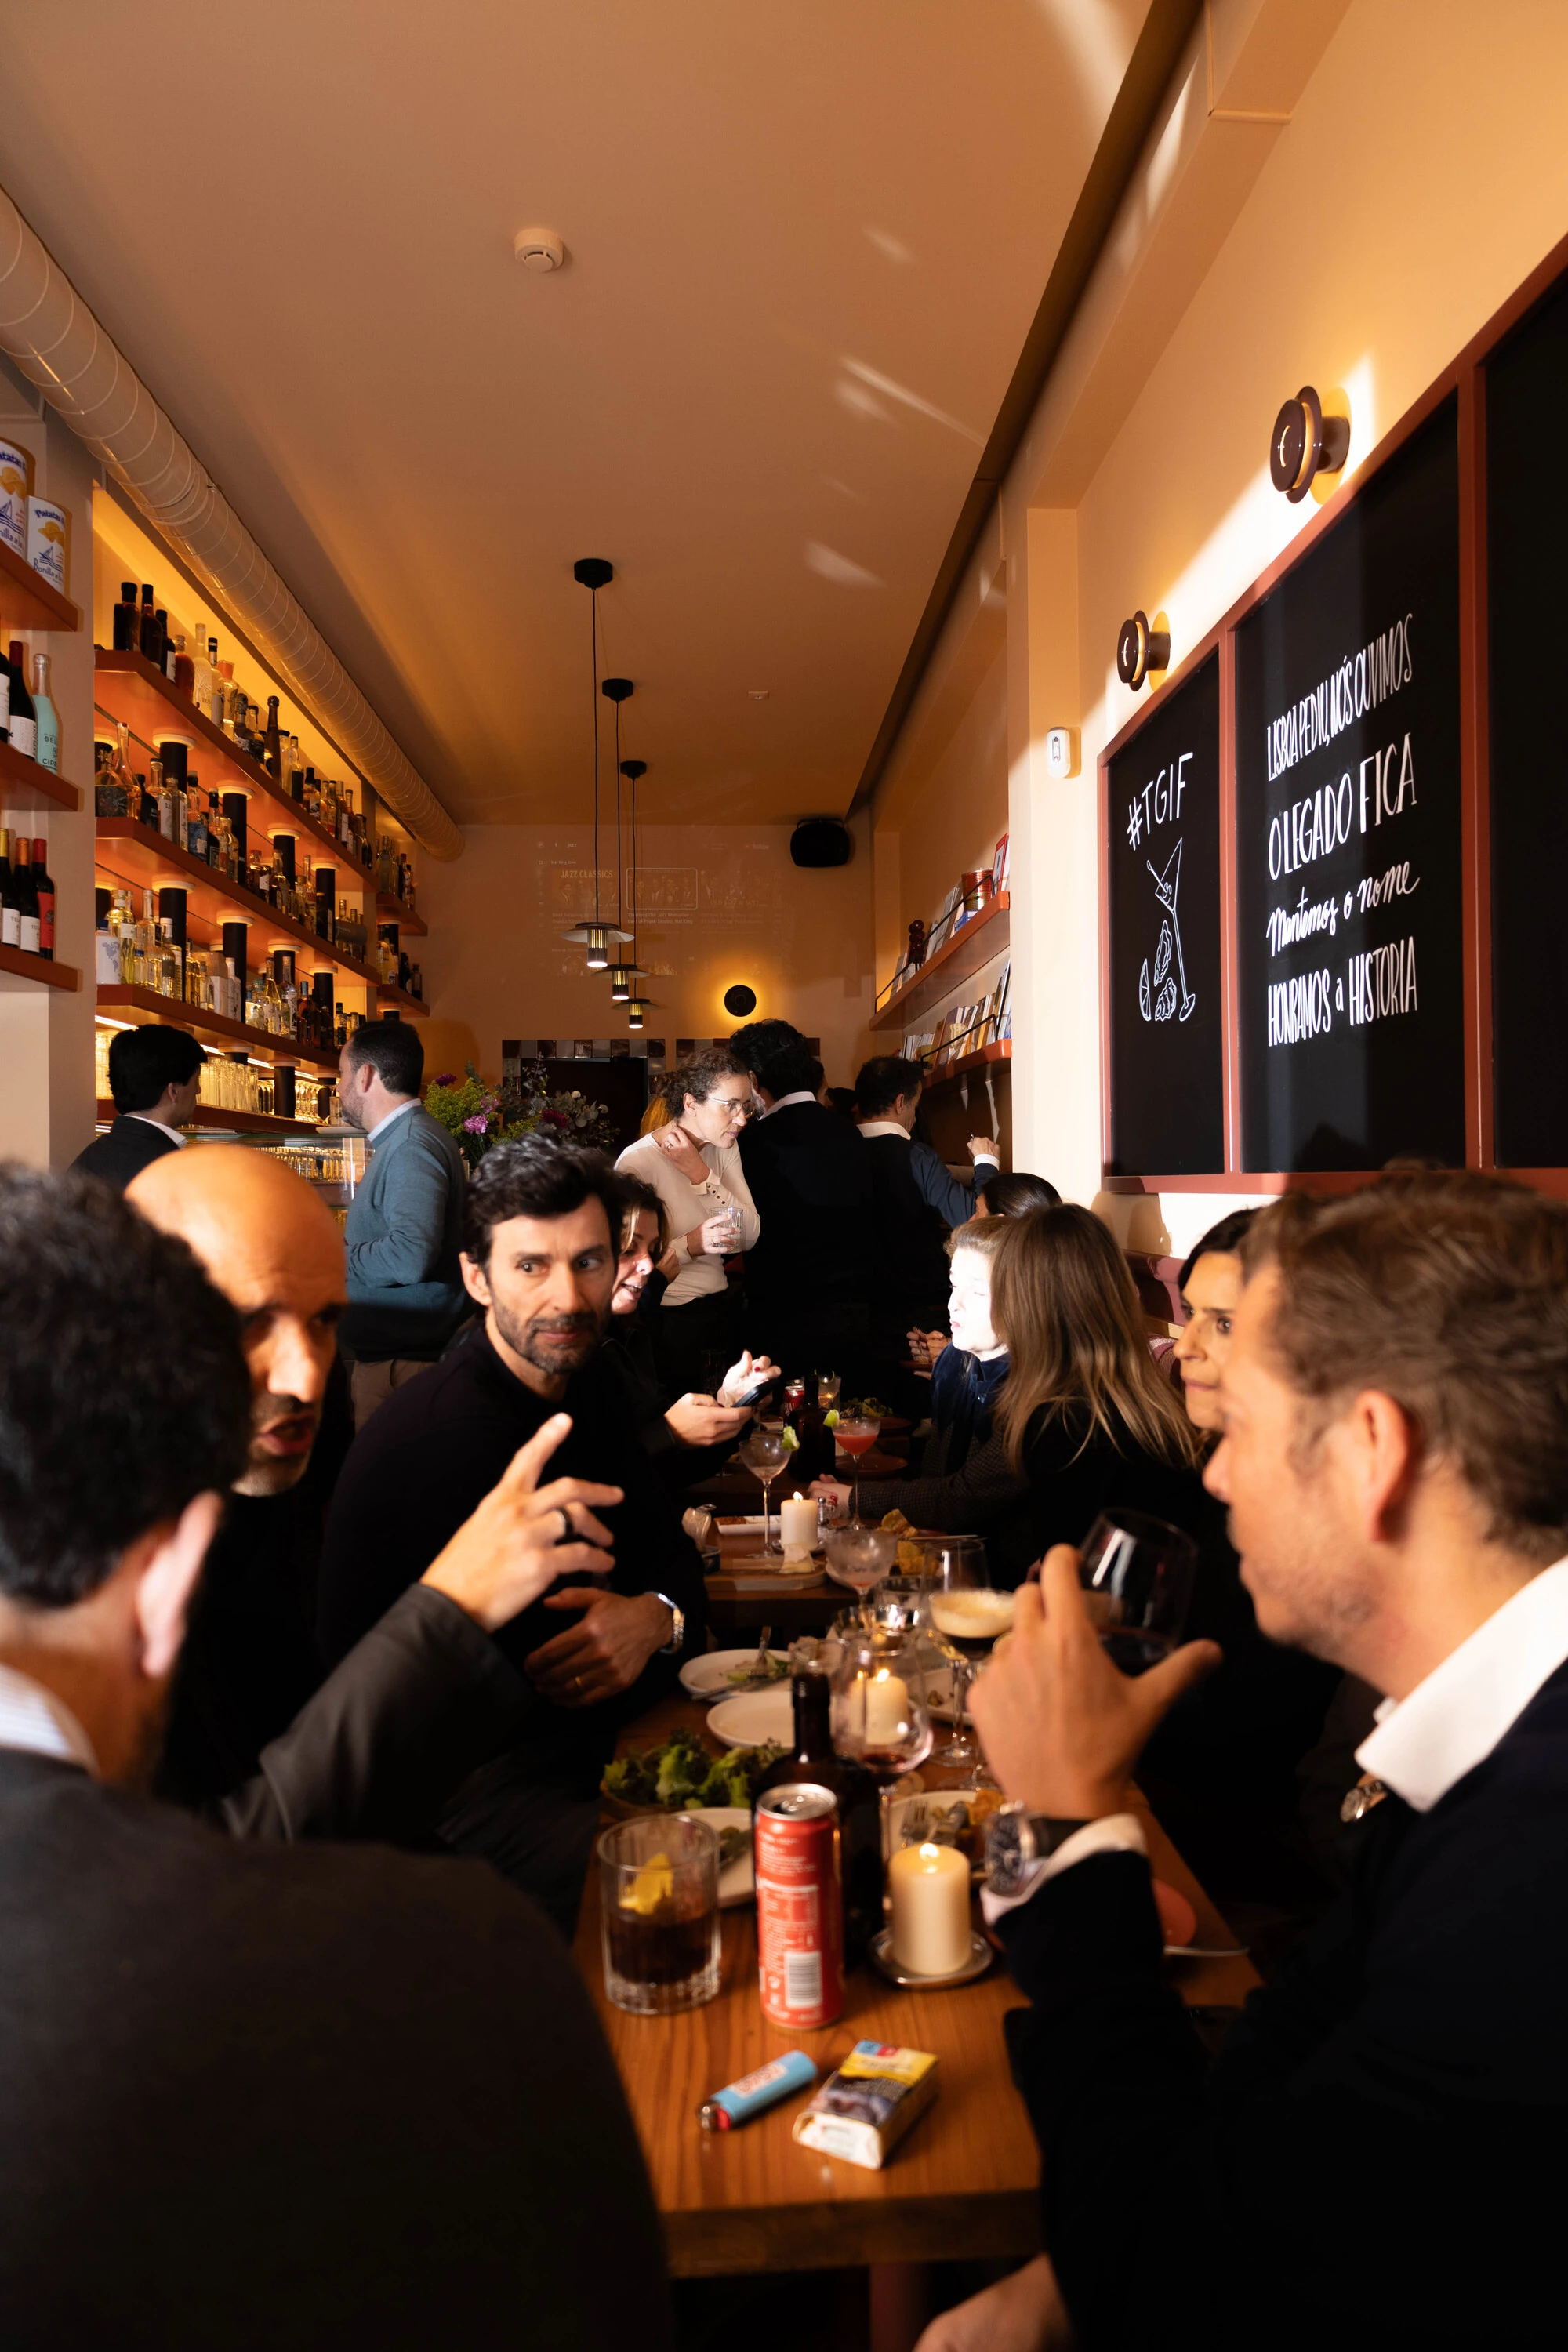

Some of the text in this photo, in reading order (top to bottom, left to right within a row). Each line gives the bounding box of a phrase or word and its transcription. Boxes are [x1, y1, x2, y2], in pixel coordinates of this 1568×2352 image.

[1266, 613, 1413, 782] LISBOA PEDIU, NÓS OUVIMOS
[1127, 752, 1193, 851] #TGIF
[1283, 773, 1352, 874] LEGADO
[1359, 732, 1417, 833] FICA
[560, 869, 613, 878] JAZZ CLASSICS
[1266, 861, 1420, 957] Mantemos o nome
[1268, 936, 1417, 1047] HONRAMOS a HISTORIA
